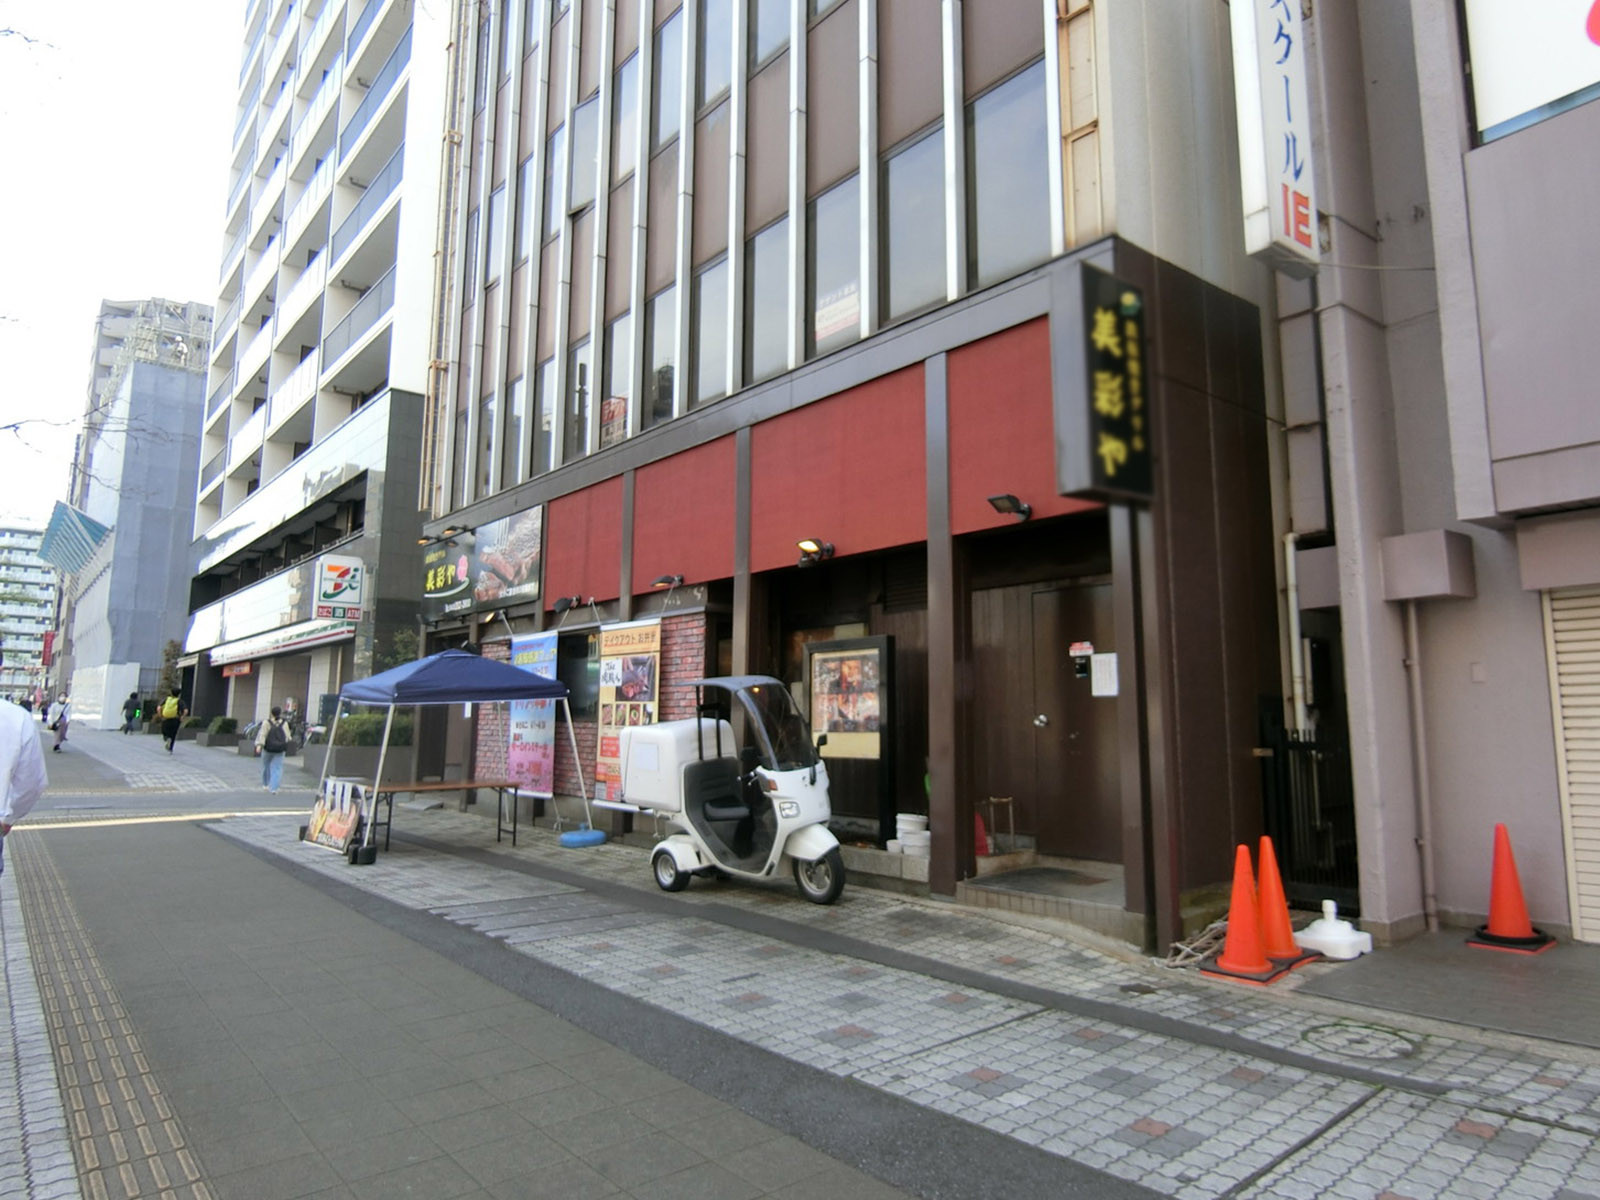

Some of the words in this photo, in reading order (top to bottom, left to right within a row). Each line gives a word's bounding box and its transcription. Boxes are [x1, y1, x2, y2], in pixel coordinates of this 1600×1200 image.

[1281, 183, 1312, 249] IE
[604, 633, 636, 647] テイクアウト
